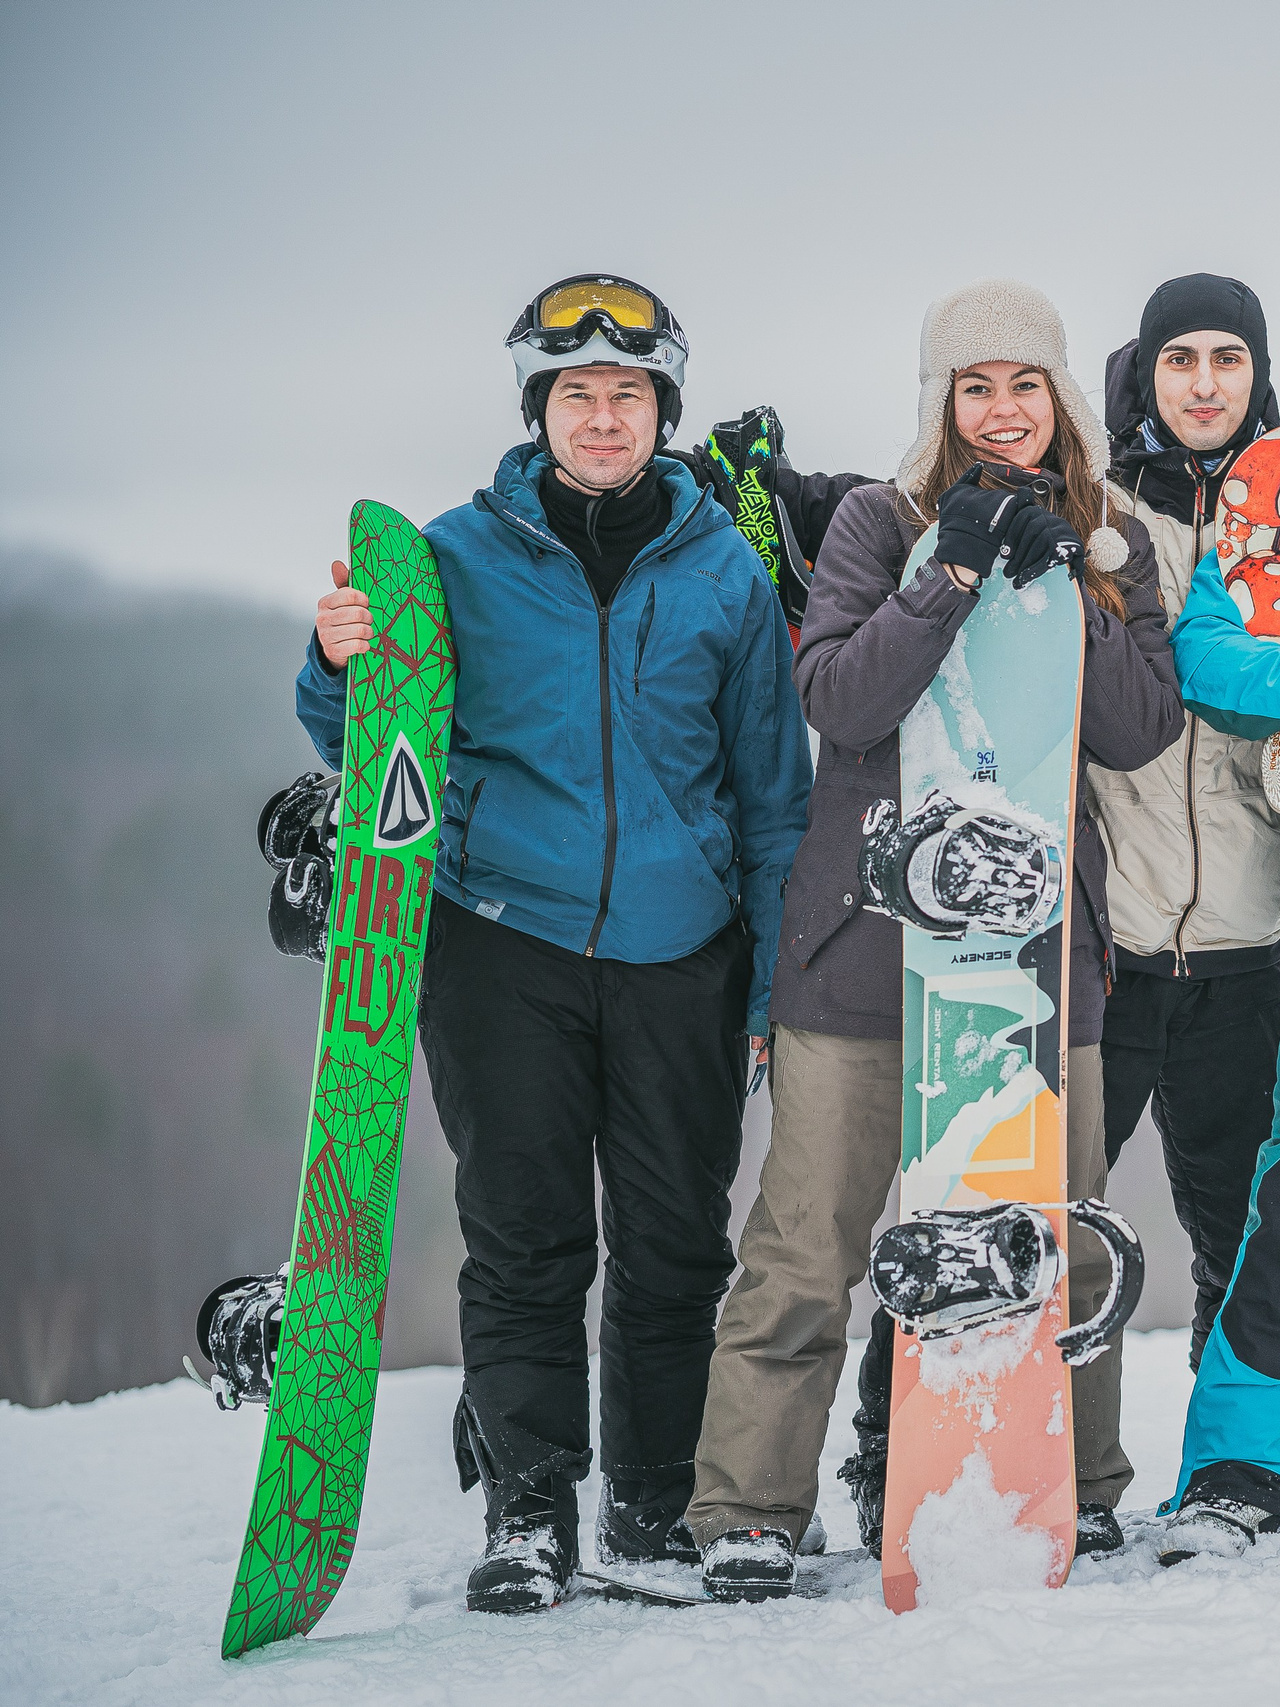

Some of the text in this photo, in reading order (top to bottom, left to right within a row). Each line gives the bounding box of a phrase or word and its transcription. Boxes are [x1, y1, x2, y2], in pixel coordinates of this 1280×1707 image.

[696, 568, 722, 584] WEDZE
[1269, 750, 1278, 770] ROME
[336, 844, 434, 950] FIRE
[951, 950, 1012, 964] SCENERY
[933, 1007, 942, 1081] JOINT RENTA
